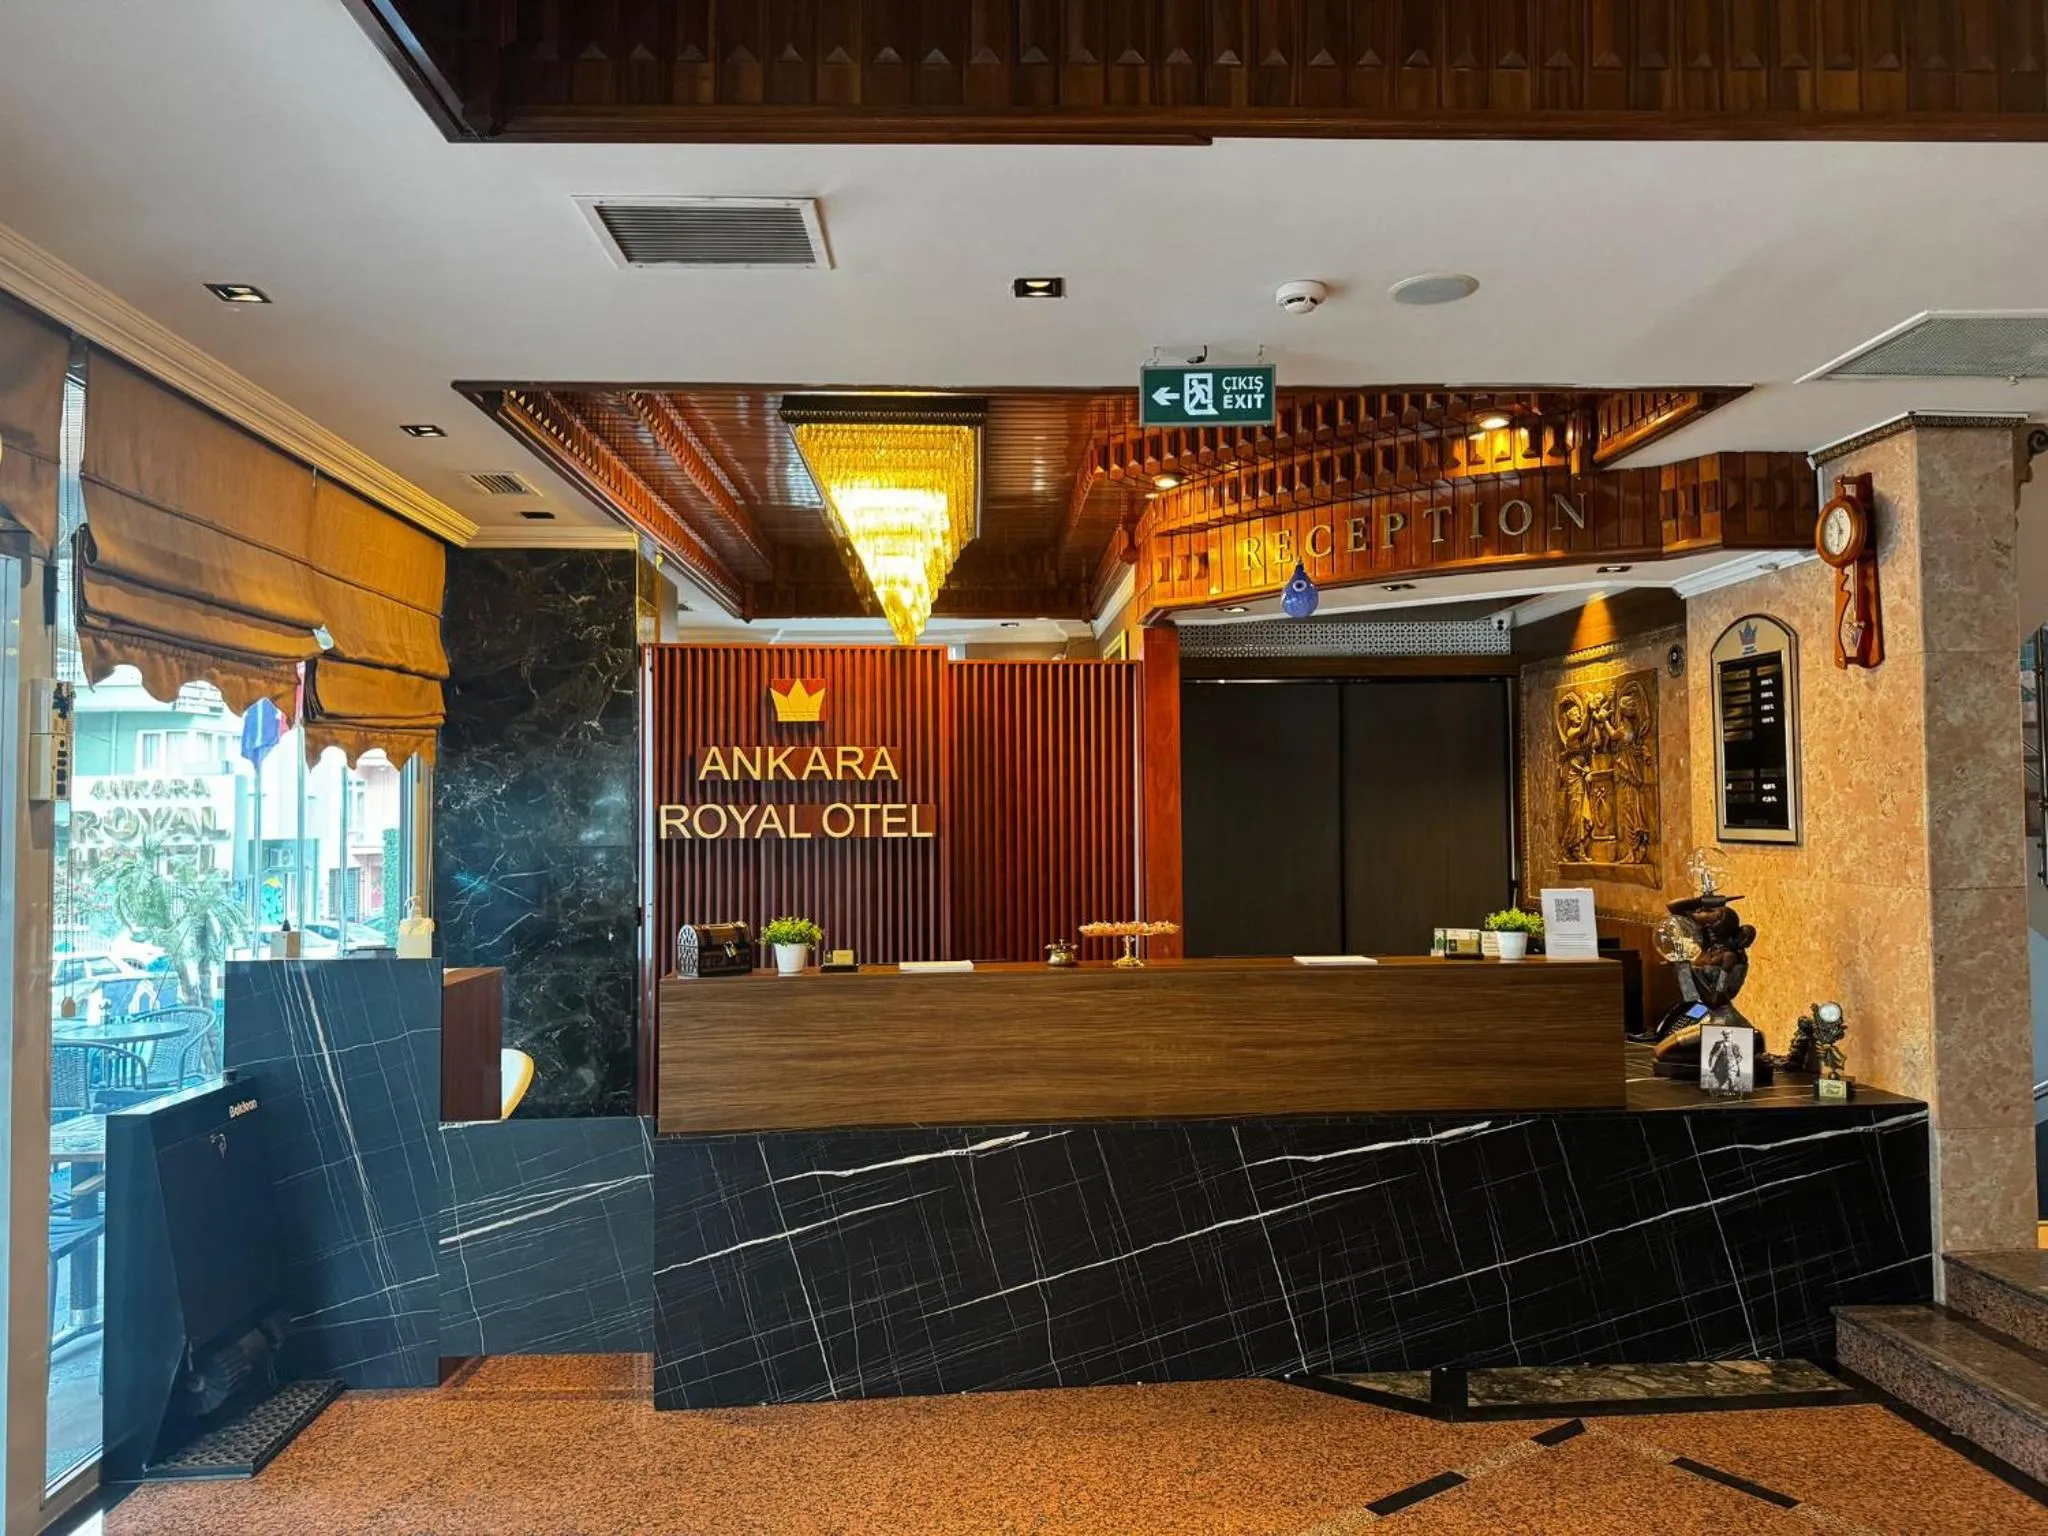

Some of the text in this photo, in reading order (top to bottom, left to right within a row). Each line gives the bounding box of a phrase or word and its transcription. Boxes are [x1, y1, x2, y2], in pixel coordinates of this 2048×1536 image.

[1221, 375, 1264, 393] ÇIKIŞ
[1222, 393, 1266, 409] EXIT
[1240, 491, 1588, 572] RECEPTION
[698, 745, 899, 781] ANKARA
[89, 777, 212, 801] ANKARA
[72, 805, 232, 844] ROYAL
[659, 802, 934, 840] ROYAL OTEL
